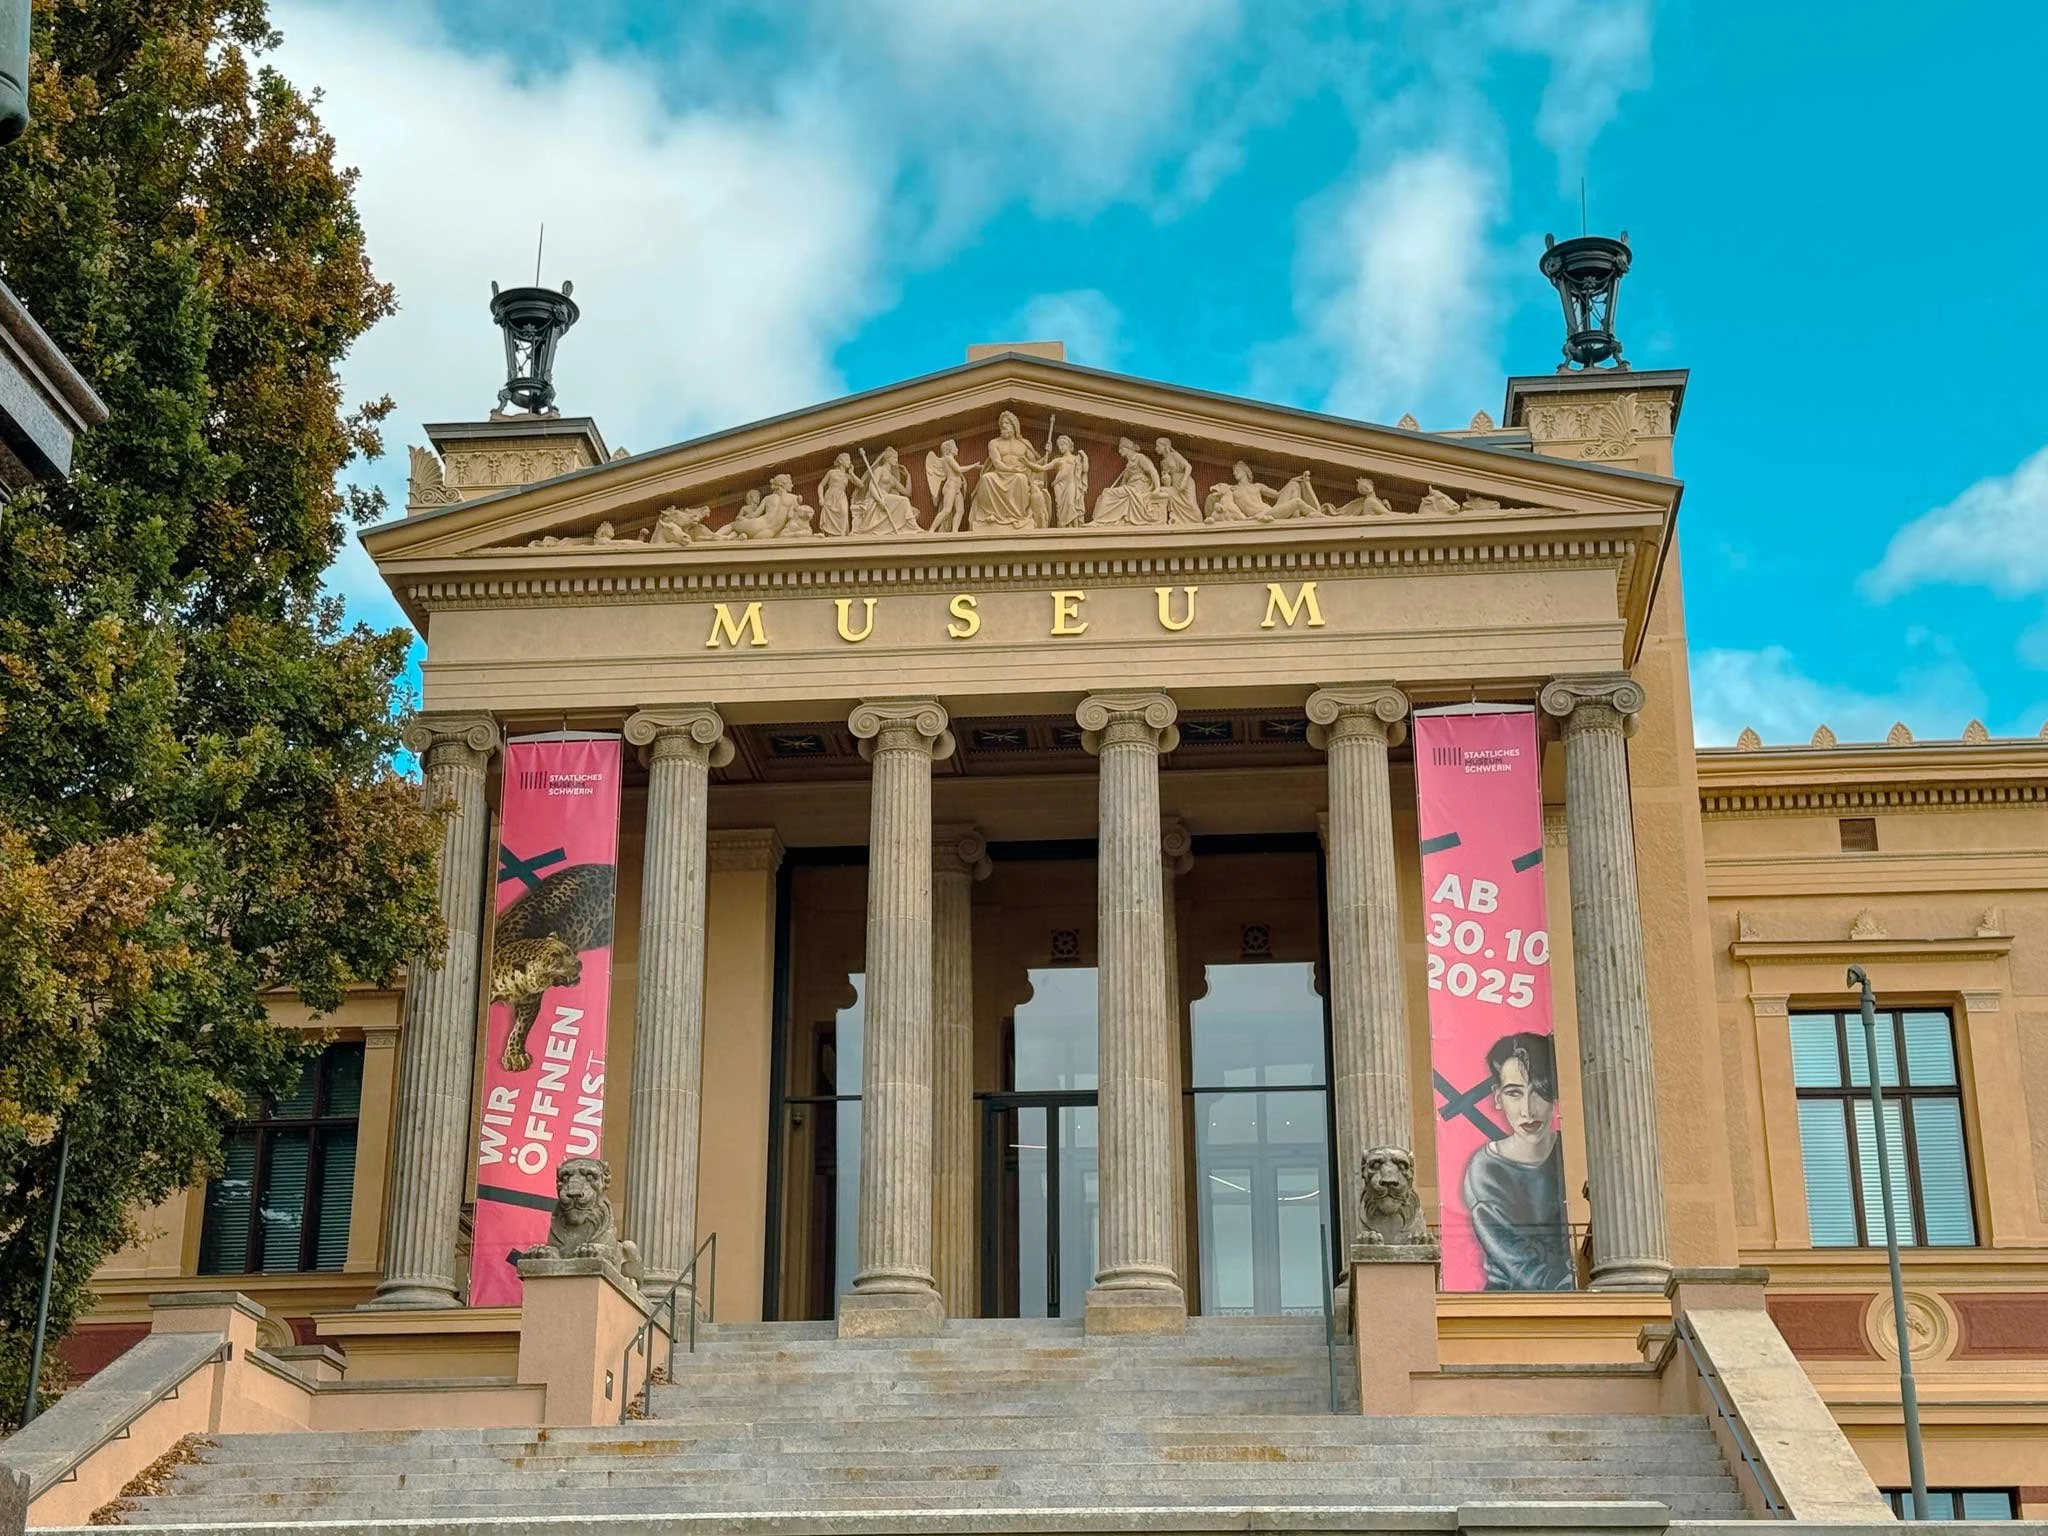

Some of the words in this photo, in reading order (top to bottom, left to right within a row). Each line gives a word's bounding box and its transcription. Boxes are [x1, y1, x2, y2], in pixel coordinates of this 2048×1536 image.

[706, 582, 1326, 647] MUSEUM
[549, 773, 603, 782] STAATLICHES
[1463, 748, 1520, 759] STAATLICHES
[1464, 764, 1512, 774] SCHWERIN
[548, 787, 594, 796] SCHWERIN
[1431, 873, 1499, 914] AB
[1428, 953, 1535, 1009] 2025
[508, 1005, 585, 1175] ÖFFNEN
[564, 1049, 606, 1162] UNST
[479, 1086, 521, 1166] WIR
